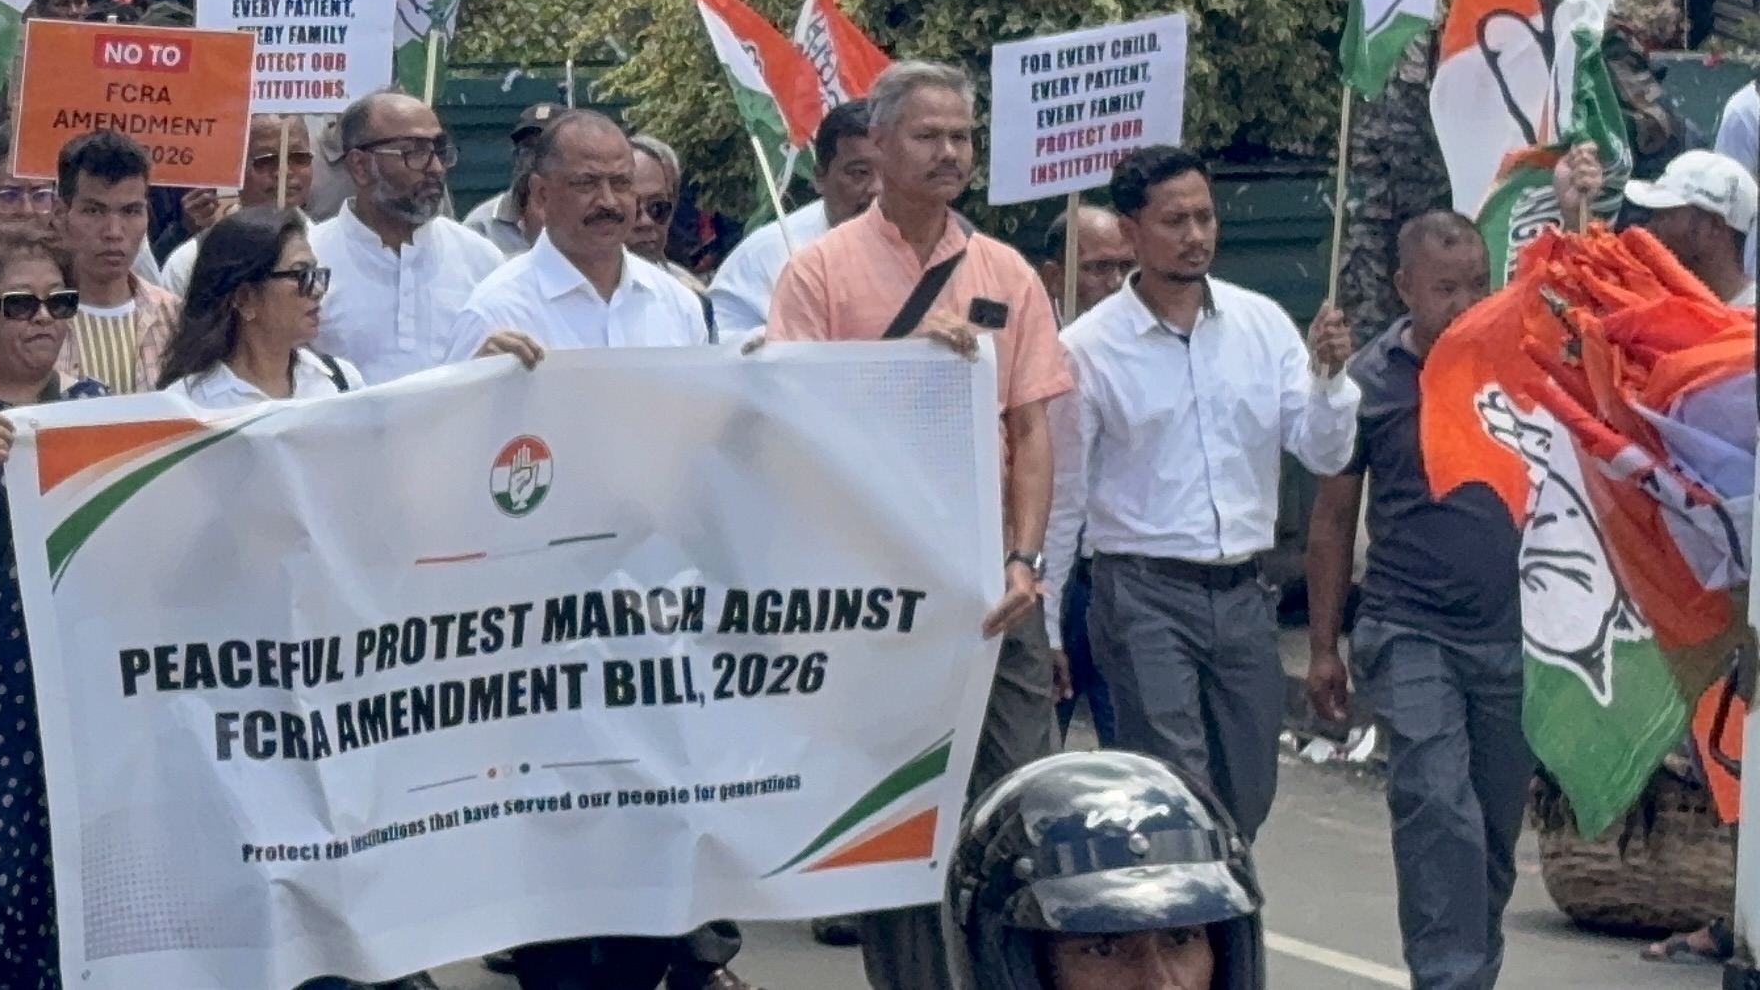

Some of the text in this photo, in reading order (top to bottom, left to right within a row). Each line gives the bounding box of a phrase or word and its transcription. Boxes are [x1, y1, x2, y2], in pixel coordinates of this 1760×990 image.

[289, 25, 348, 45] FAMILY
[104, 42, 182, 67] NO TO
[256, 52, 347, 72] OTECT OUR
[1020, 52, 1052, 76] FOR
[1056, 42, 1106, 70] EVERY
[106, 82, 172, 105] FCRA
[255, 79, 350, 100] TITUTIONS.
[1031, 75, 1081, 103] EVERY
[52, 109, 218, 137] AMENDMENT
[1037, 90, 1146, 130] EVERY FAMILY
[1036, 118, 1143, 158] PROTECT OUR
[144, 145, 194, 166] 026
[119, 586, 927, 697] PEACEFUL PROTEST MARCH AGAINST
[215, 651, 829, 761] FCRA AMENDMENT BILL, 2026
[242, 773, 802, 863] Protect the institutions that have served our people for generations
